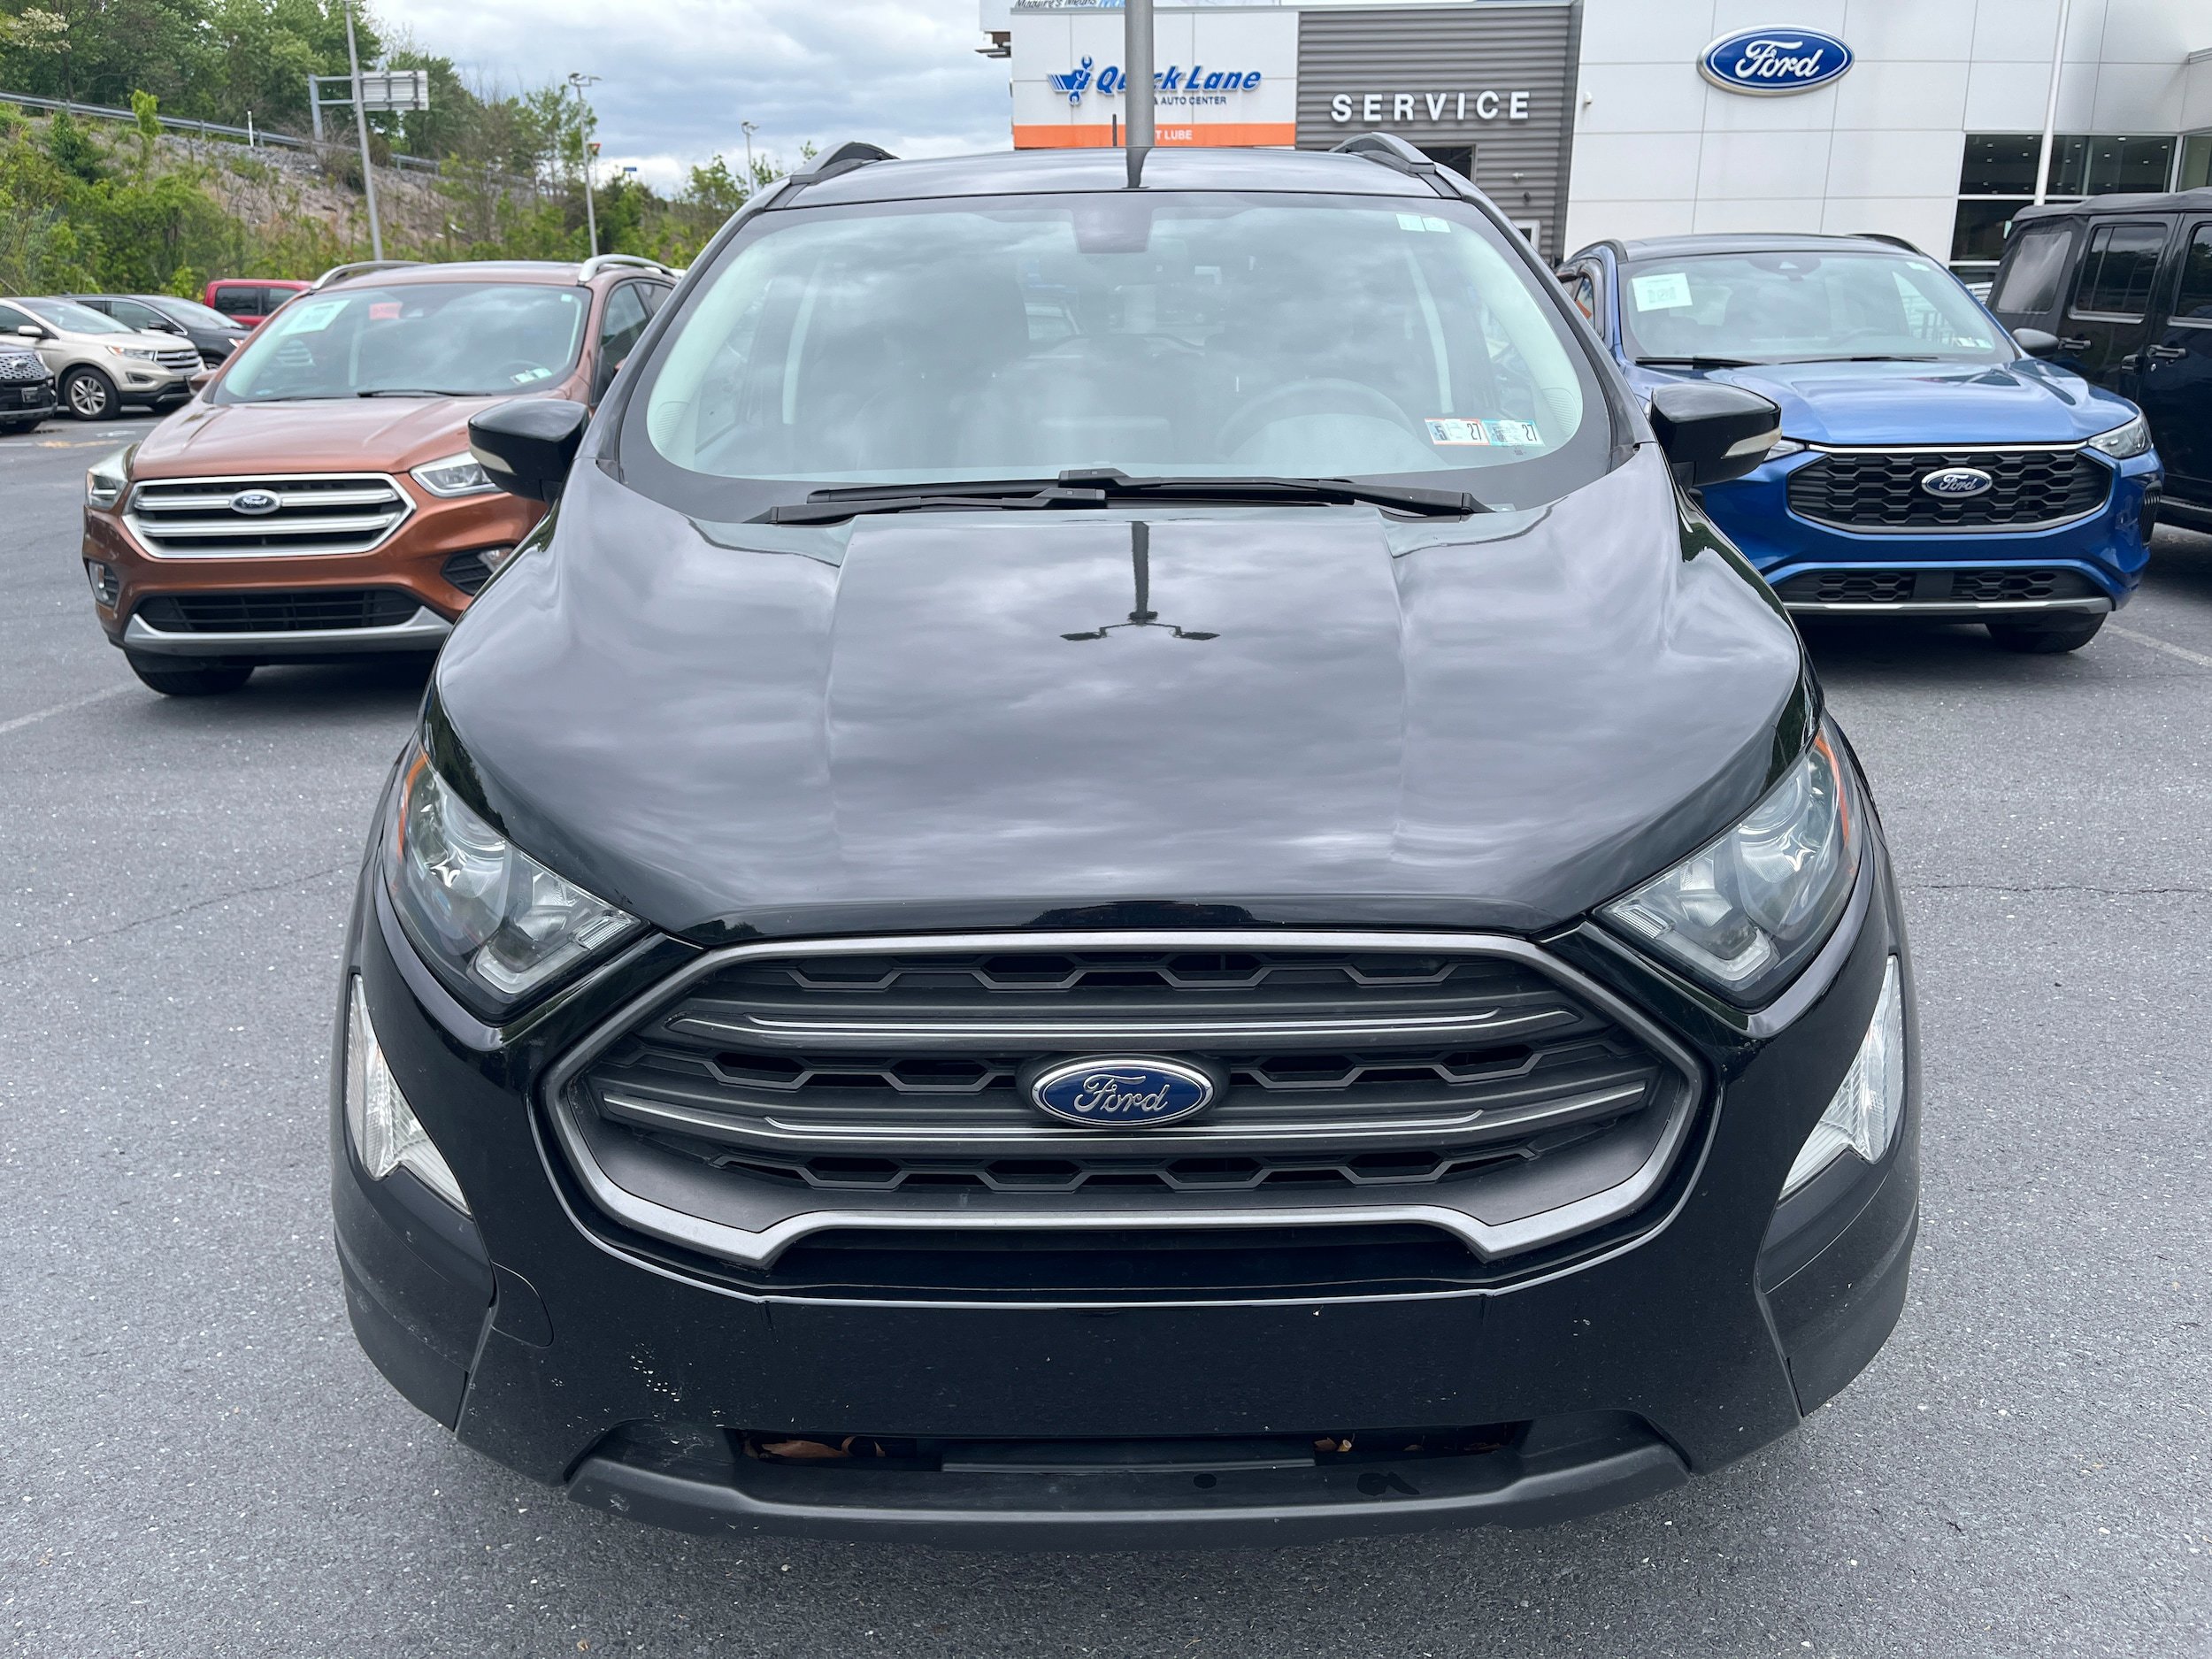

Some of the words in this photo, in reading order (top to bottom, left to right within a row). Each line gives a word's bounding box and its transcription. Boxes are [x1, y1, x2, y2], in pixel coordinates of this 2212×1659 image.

[1735, 39, 1824, 79] Ford
[1096, 65, 1182, 94] Qck
[1186, 65, 1263, 91] Lane
[1161, 96, 1187, 105] AUTO
[1189, 96, 1227, 105] CENTER
[1330, 90, 1531, 122] SERVICE
[1164, 130, 1193, 140] LUBE
[1467, 423, 1482, 442] 27
[1522, 424, 1538, 442] 27
[1939, 474, 1978, 491] Ford
[1073, 1073, 1171, 1113] Ford
